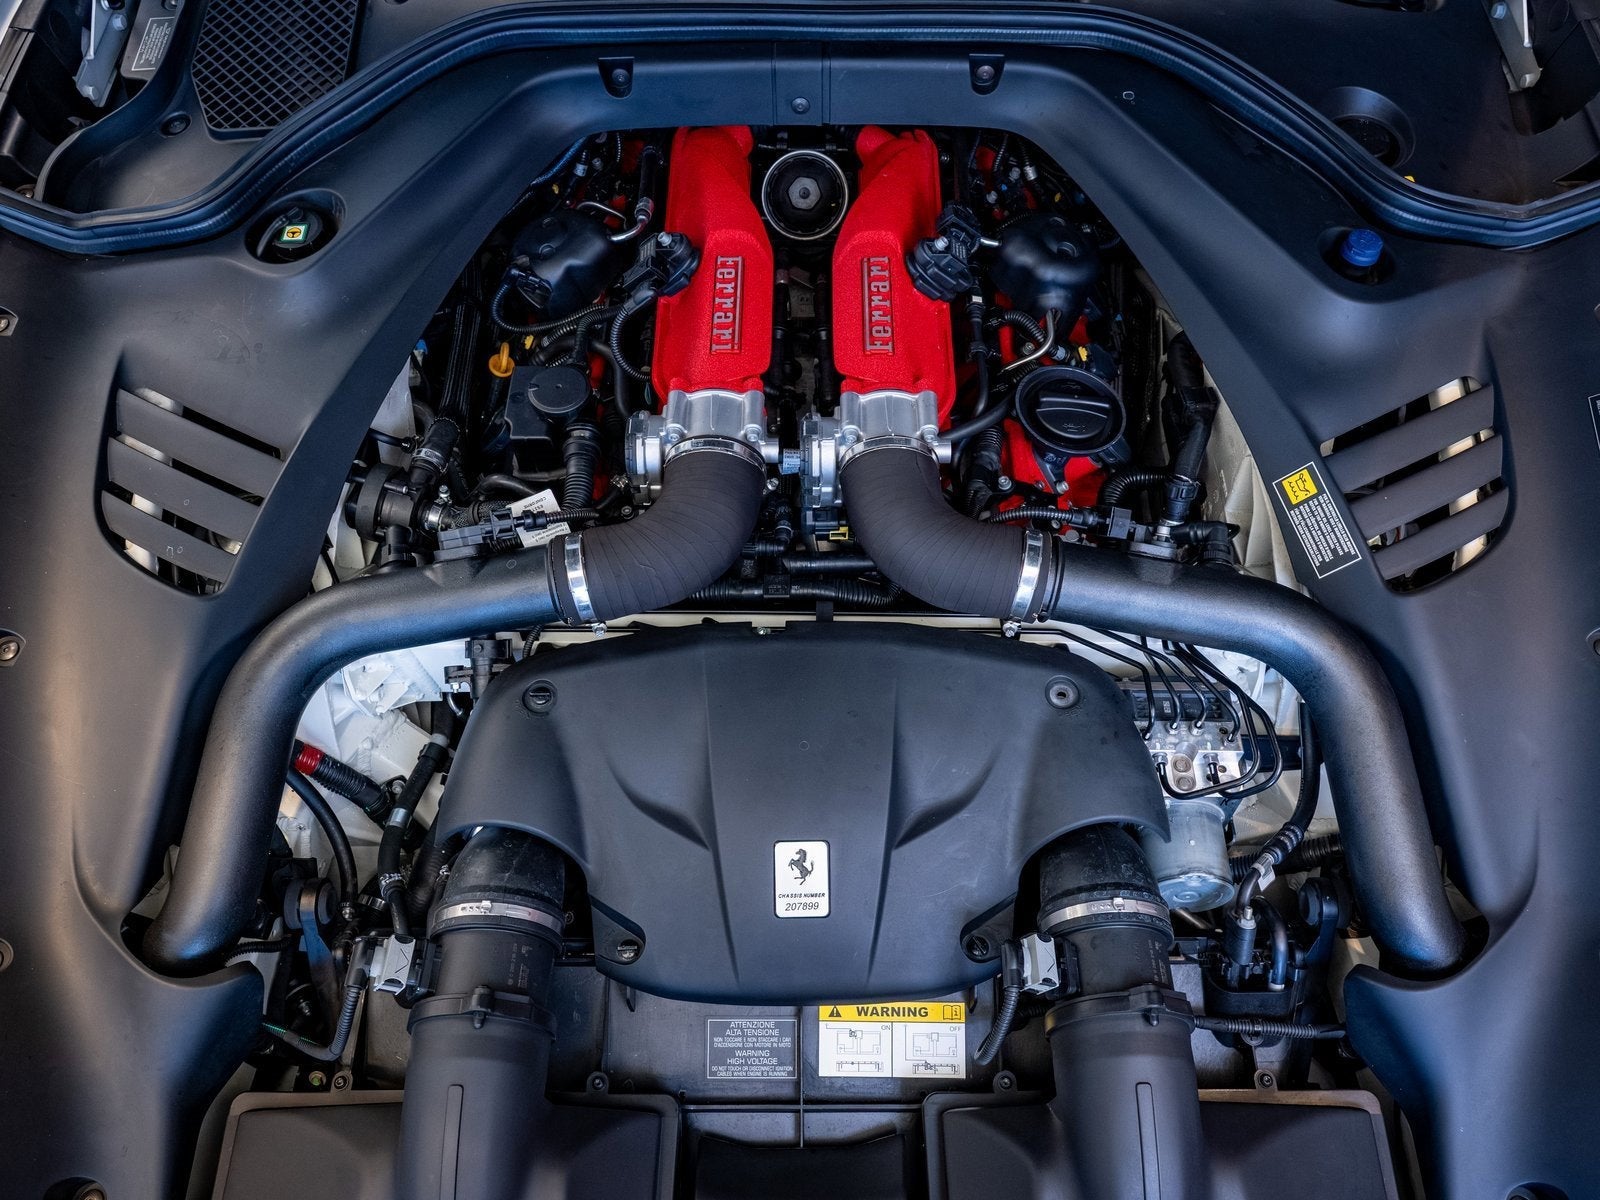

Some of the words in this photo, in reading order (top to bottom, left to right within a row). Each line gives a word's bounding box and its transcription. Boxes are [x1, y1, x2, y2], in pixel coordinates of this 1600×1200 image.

[711, 255, 742, 354] Ferrari
[864, 256, 893, 356] Ferrari
[785, 902, 819, 911] 207899
[856, 1006, 928, 1017] WARNING
